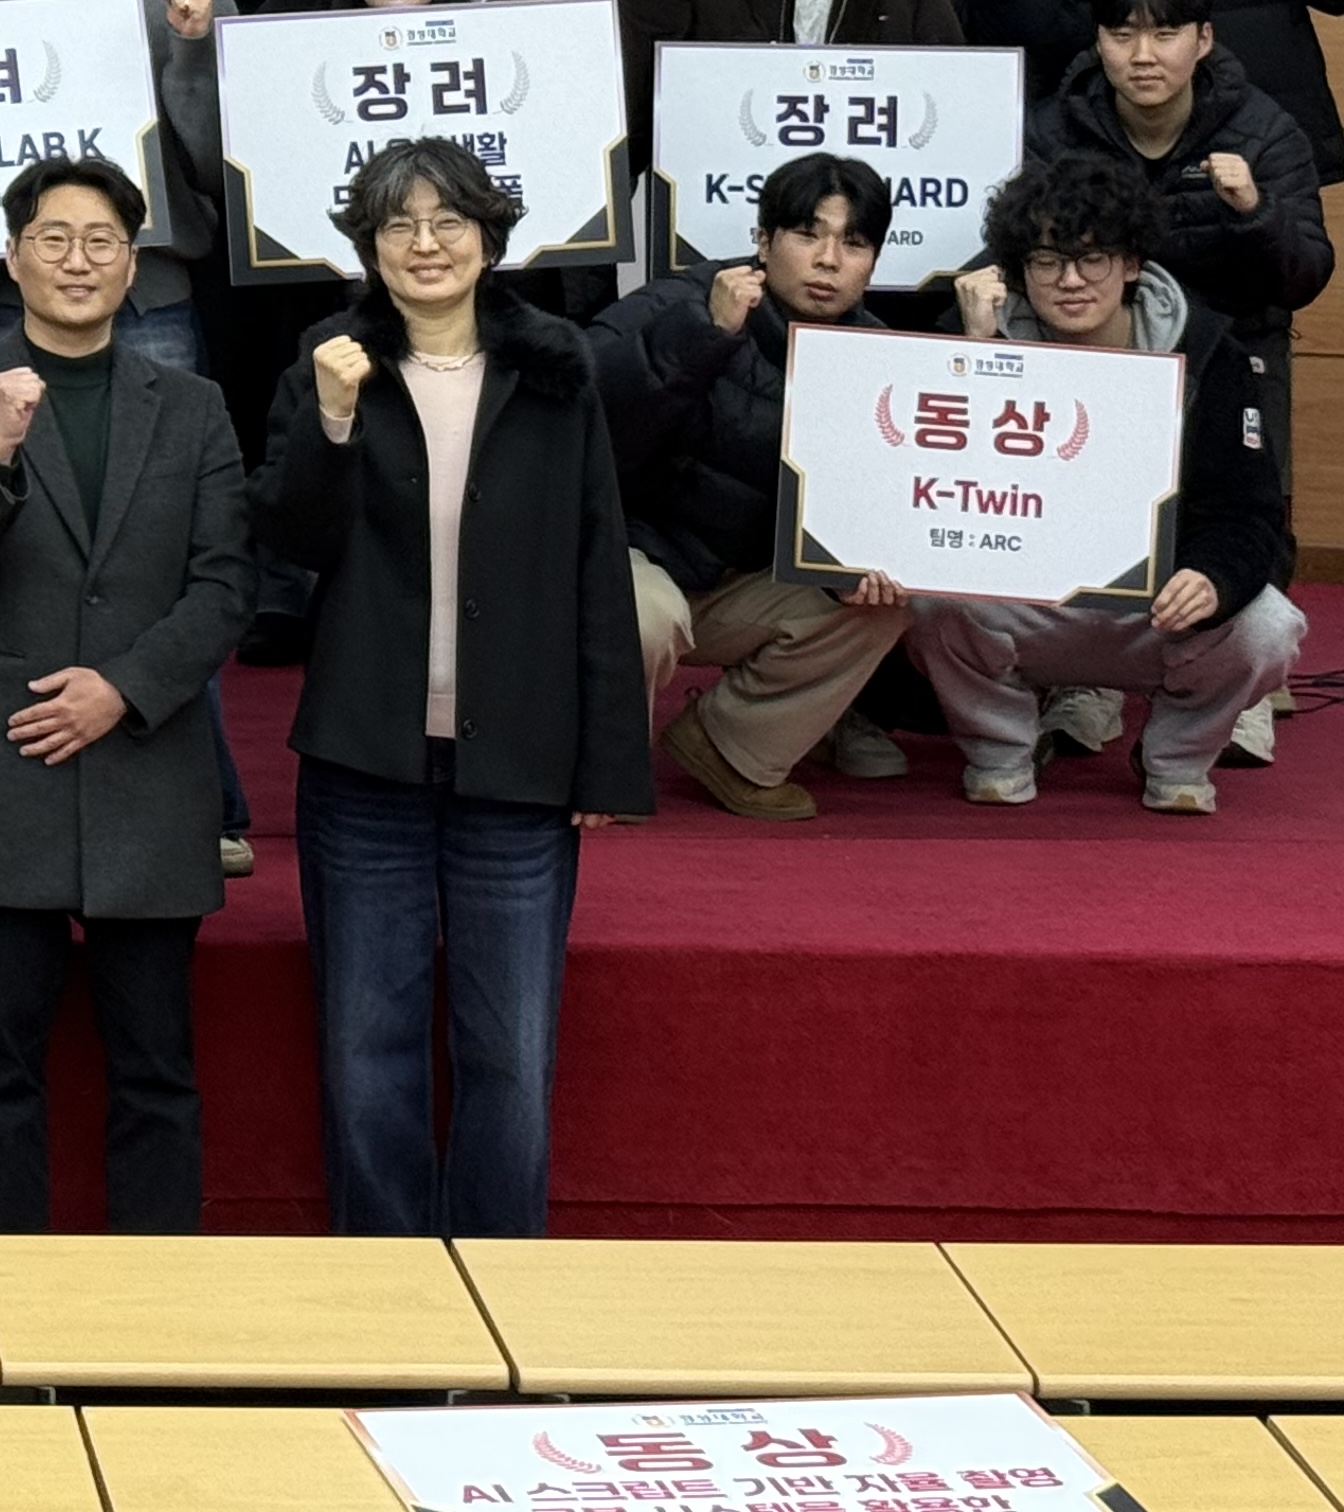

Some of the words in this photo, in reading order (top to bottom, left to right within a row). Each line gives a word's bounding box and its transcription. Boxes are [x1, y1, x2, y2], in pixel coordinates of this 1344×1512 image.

[912, 476, 1043, 518] K-Twin
[929, 528, 963, 549] 팀명
[979, 533, 1022, 552] ARC
[463, 1484, 514, 1504] AI
[527, 1478, 728, 1502] 스크립트
[733, 1475, 841, 1498] 기반
[844, 1472, 954, 1493] 자율
[957, 1466, 1064, 1489] 촬영
